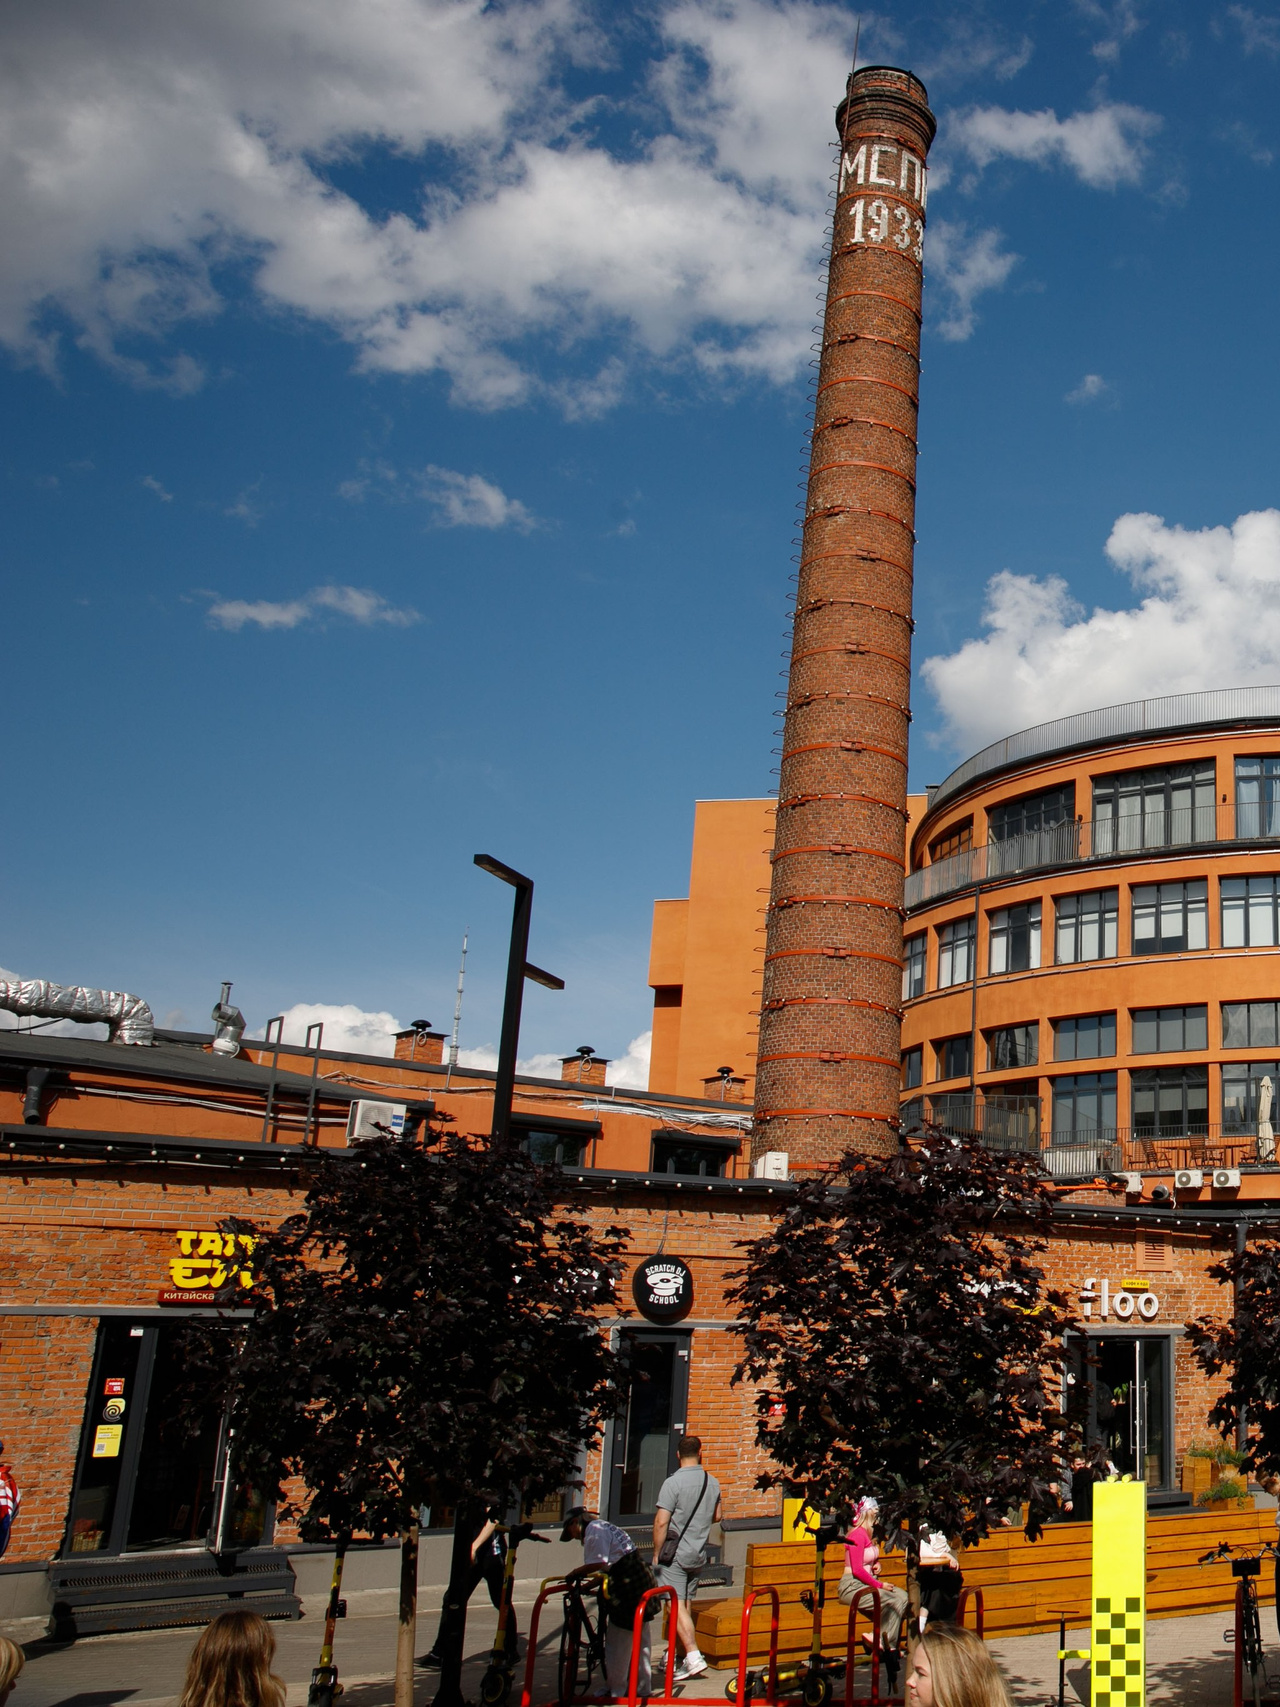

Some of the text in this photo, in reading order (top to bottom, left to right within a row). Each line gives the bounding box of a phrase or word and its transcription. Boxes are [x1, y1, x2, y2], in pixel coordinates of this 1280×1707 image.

[645, 1264, 686, 1277] SCRATCH DJ
[163, 1291, 216, 1300] китайска
[649, 1294, 679, 1304] SCHOOL
[1080, 1278, 1159, 1317] floo
